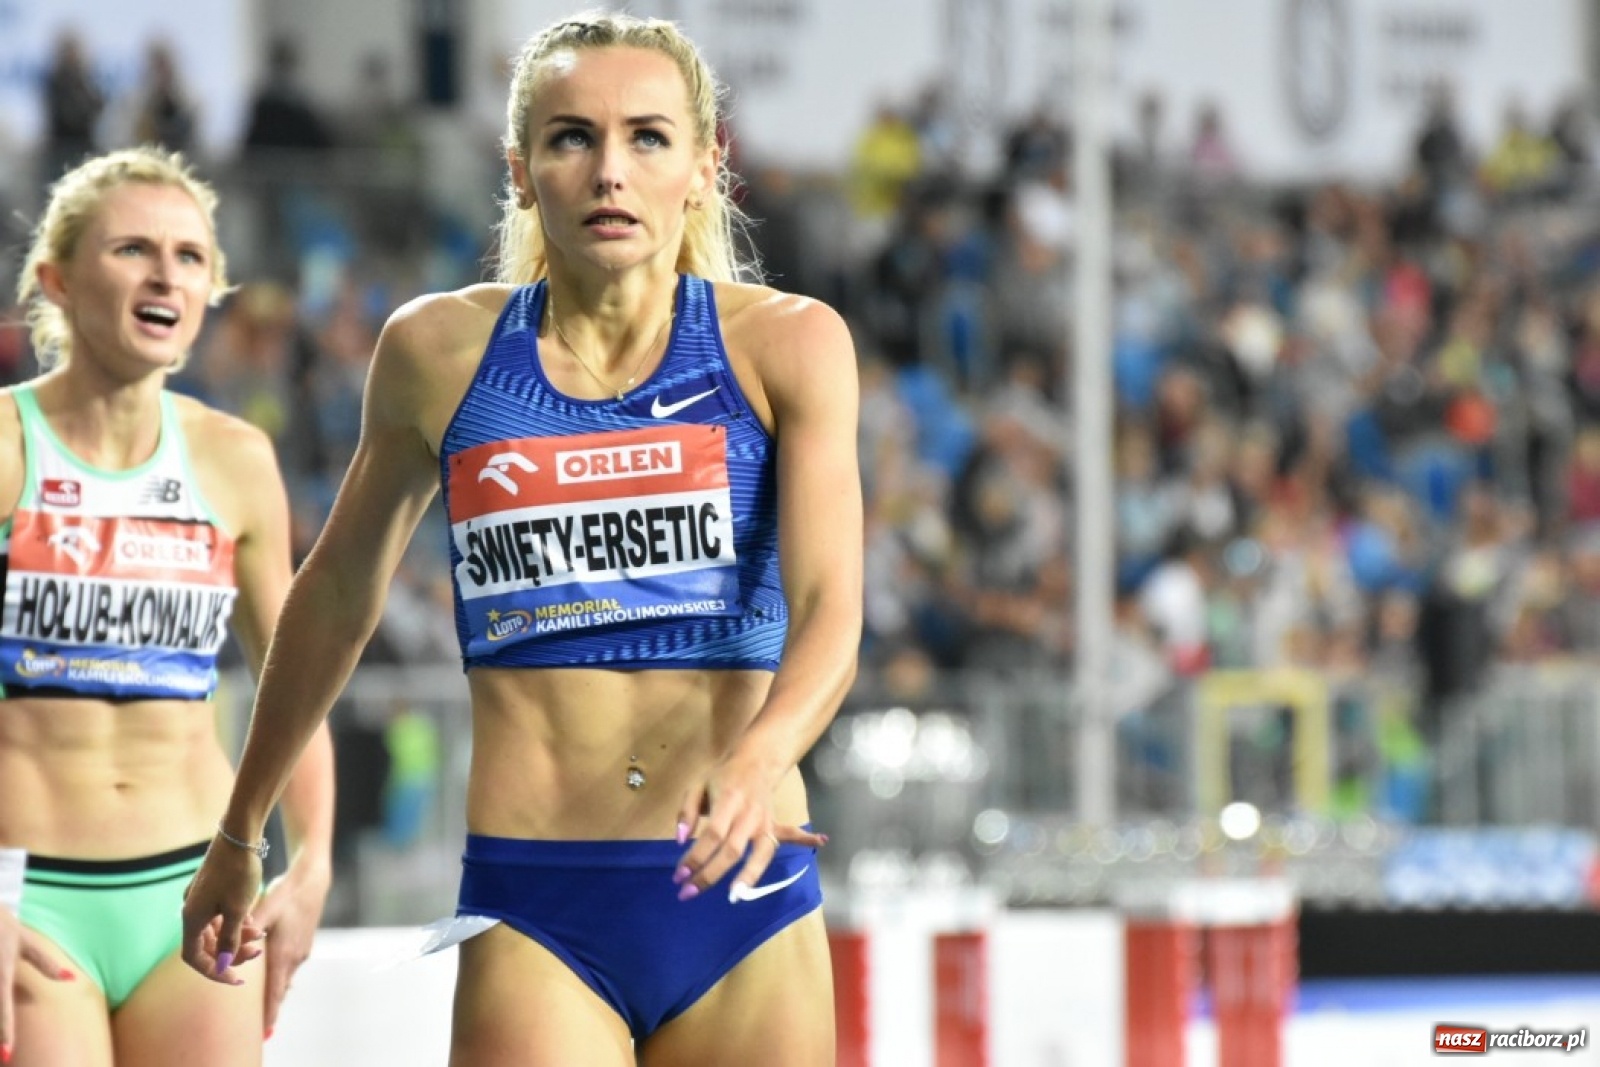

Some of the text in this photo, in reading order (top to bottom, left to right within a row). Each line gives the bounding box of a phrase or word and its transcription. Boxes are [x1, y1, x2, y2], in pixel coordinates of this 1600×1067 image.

[563, 446, 673, 477] ORLEN
[466, 502, 722, 587] ŚWIĘTY-ERSETIC
[16, 577, 227, 650] HOŁUB-KOWALIK
[535, 598, 622, 619] MEMORIAŁ
[535, 600, 727, 633] KAMILI SKOLIMOWSKIEJ
[494, 617, 523, 637] LOTTO
